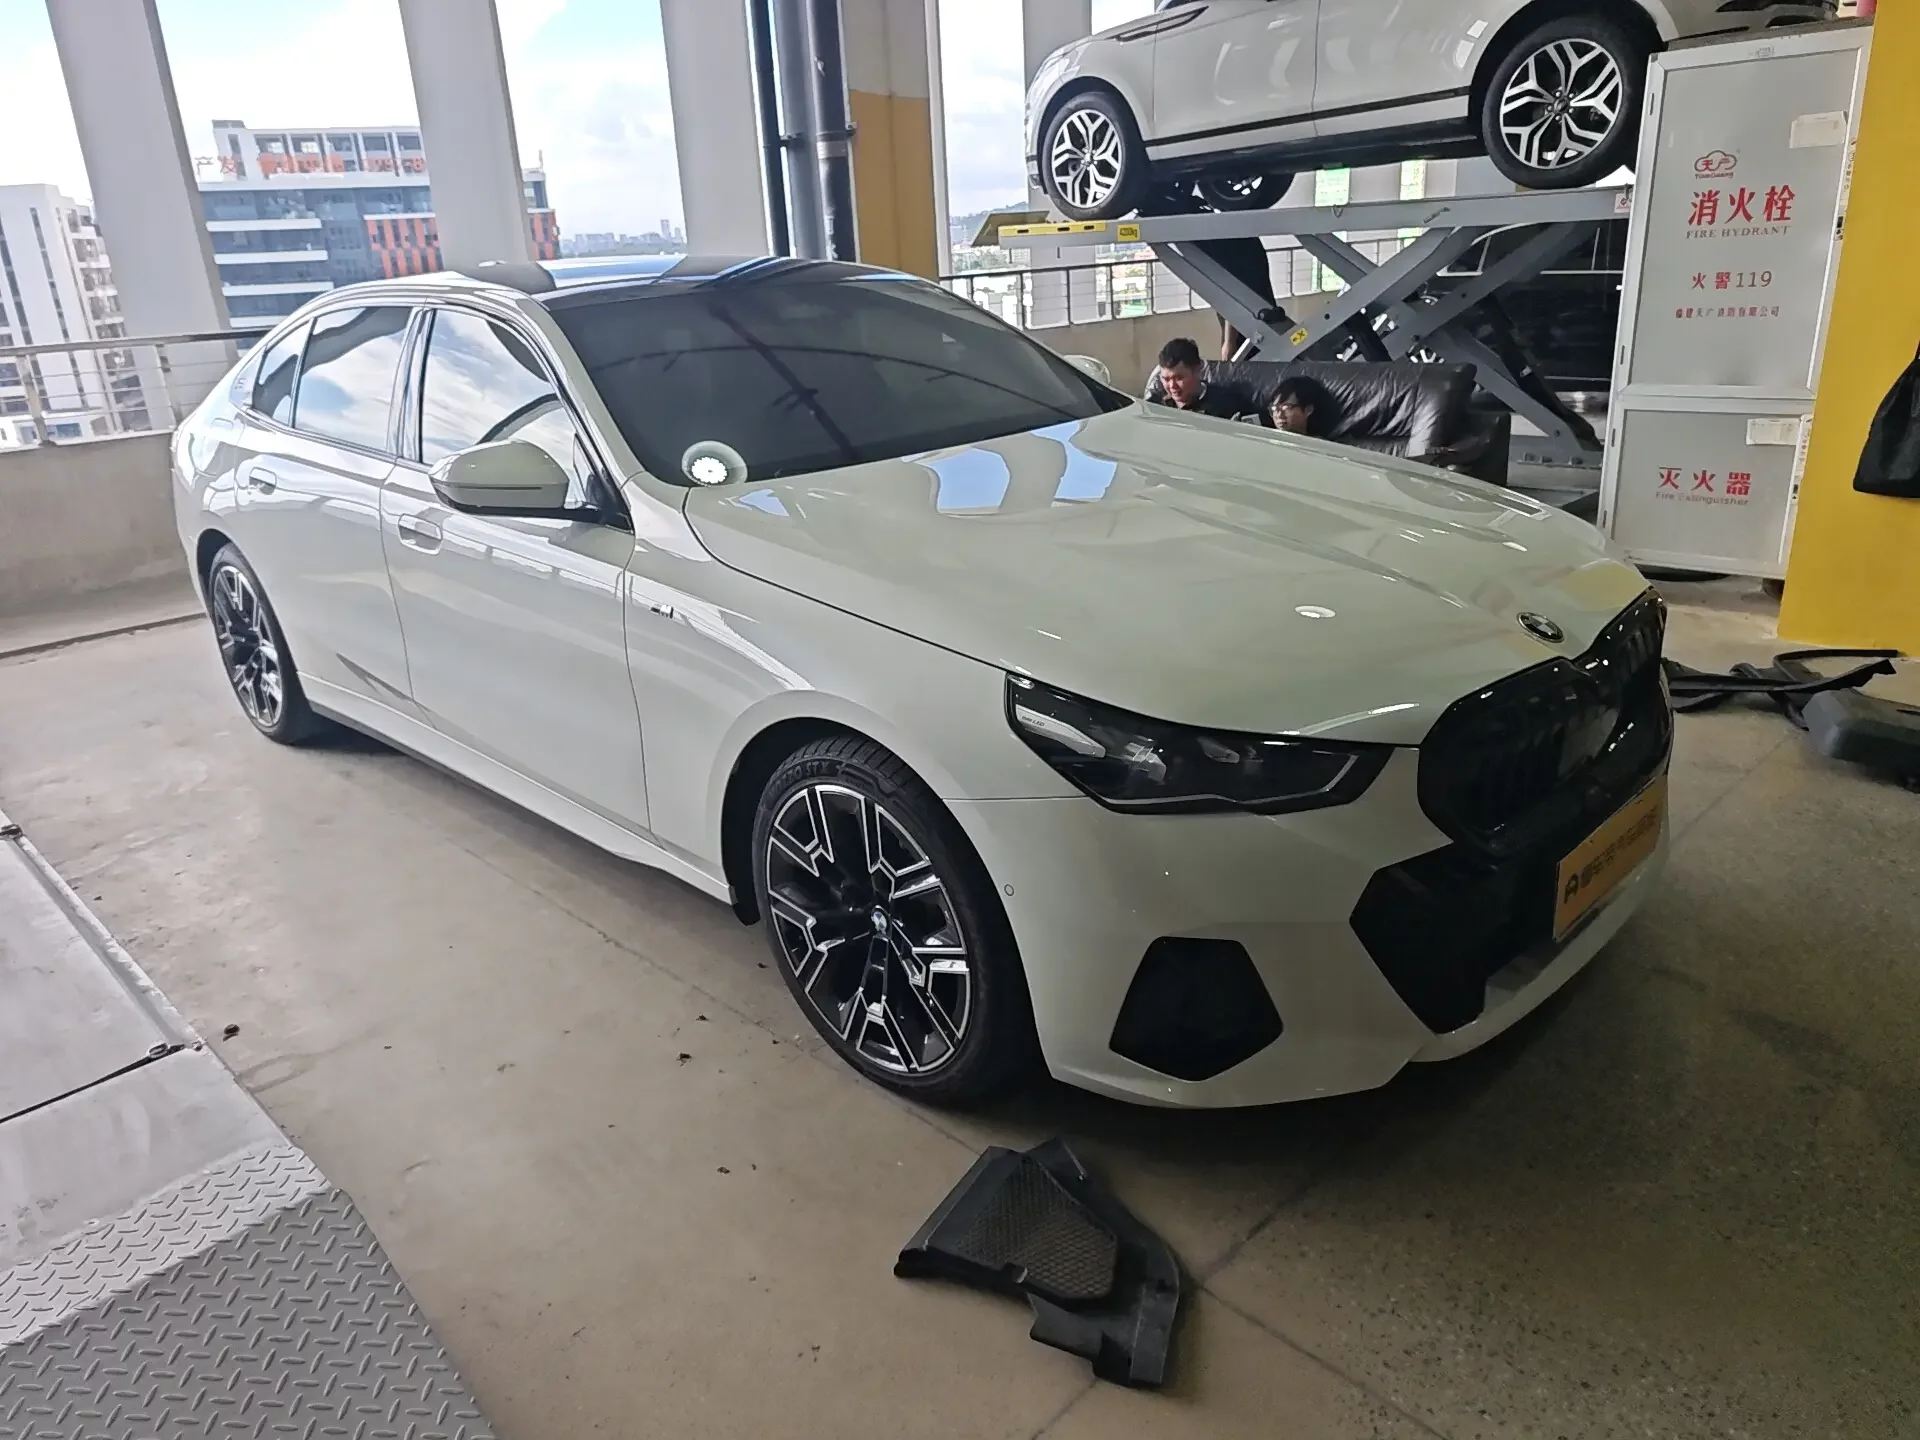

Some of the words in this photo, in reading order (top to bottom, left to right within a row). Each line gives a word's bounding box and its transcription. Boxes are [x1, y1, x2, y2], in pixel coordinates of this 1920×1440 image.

[1688, 185, 1796, 226] 消火栓
[1686, 228, 1717, 239] FIRE
[1721, 225, 1792, 238] HYDRANT
[1657, 466, 1752, 496] 灭火器
[1655, 491, 1675, 500] Fire
